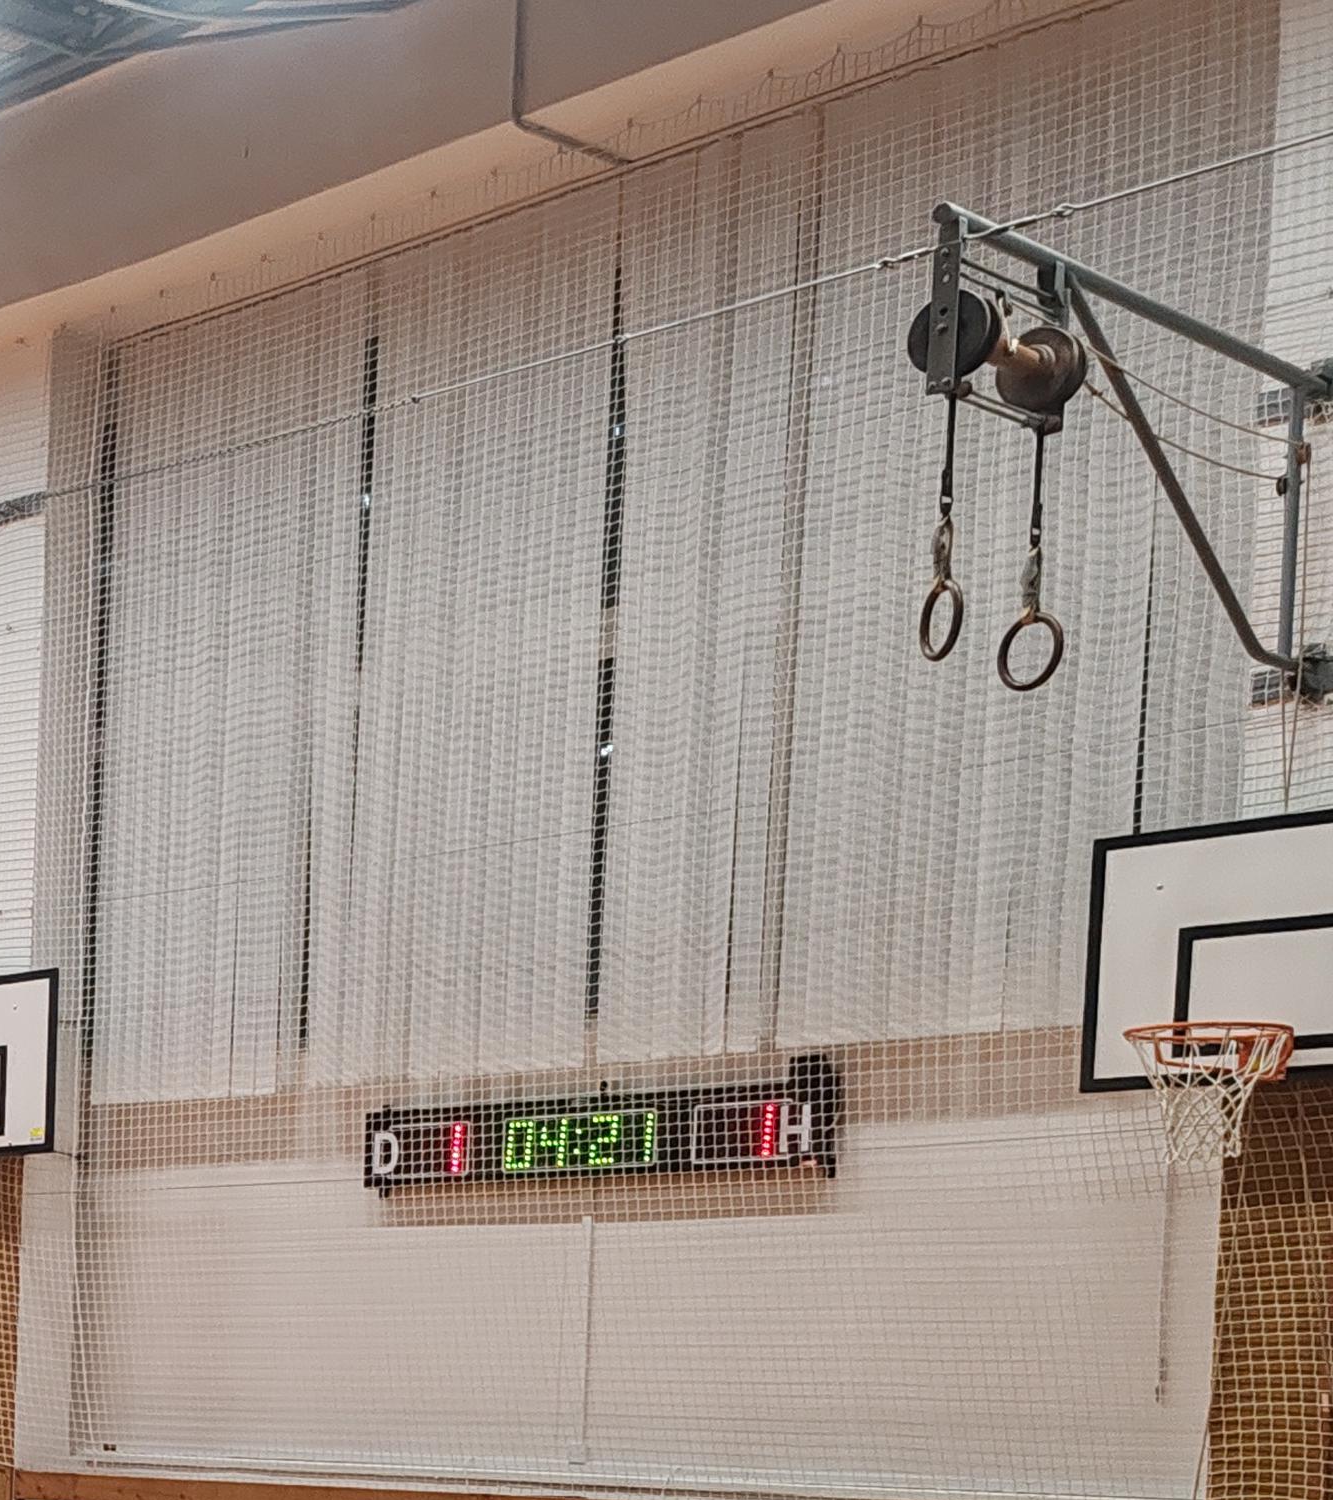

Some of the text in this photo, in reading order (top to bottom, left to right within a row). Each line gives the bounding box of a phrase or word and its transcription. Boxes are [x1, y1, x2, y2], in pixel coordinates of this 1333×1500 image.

[372, 1132, 400, 1174] D
[505, 1112, 656, 1169] 04:21
[779, 1104, 812, 1153] H
